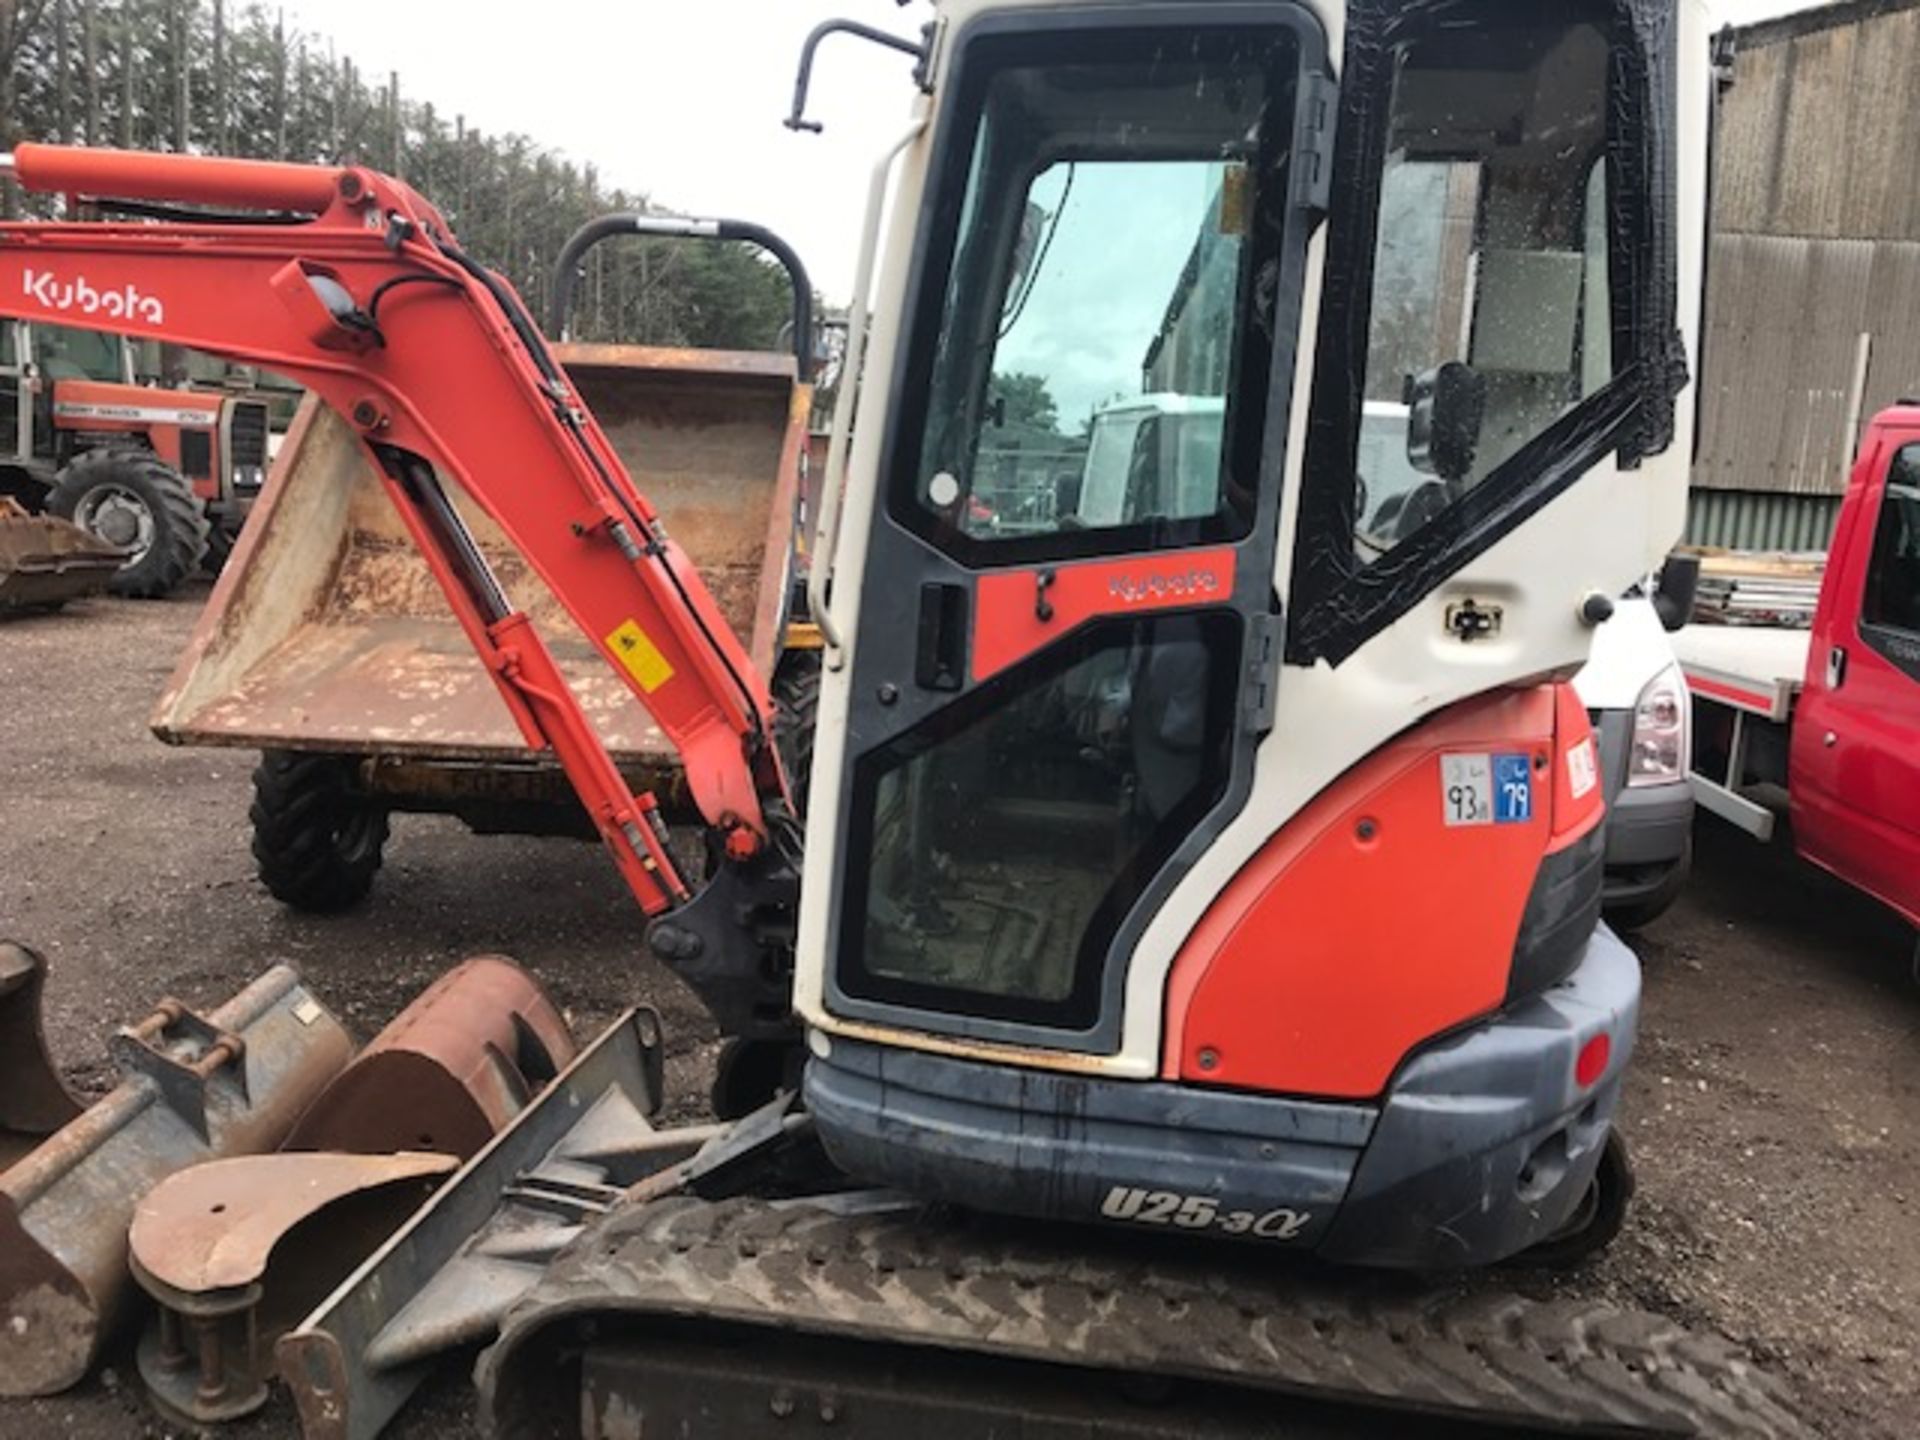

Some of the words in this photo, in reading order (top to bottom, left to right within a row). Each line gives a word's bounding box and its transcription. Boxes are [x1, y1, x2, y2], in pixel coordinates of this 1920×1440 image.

[22, 268, 163, 324] Kubota
[1108, 568, 1218, 602] Kubota
[1448, 785, 1477, 819] 93
[1503, 782, 1528, 818] 79
